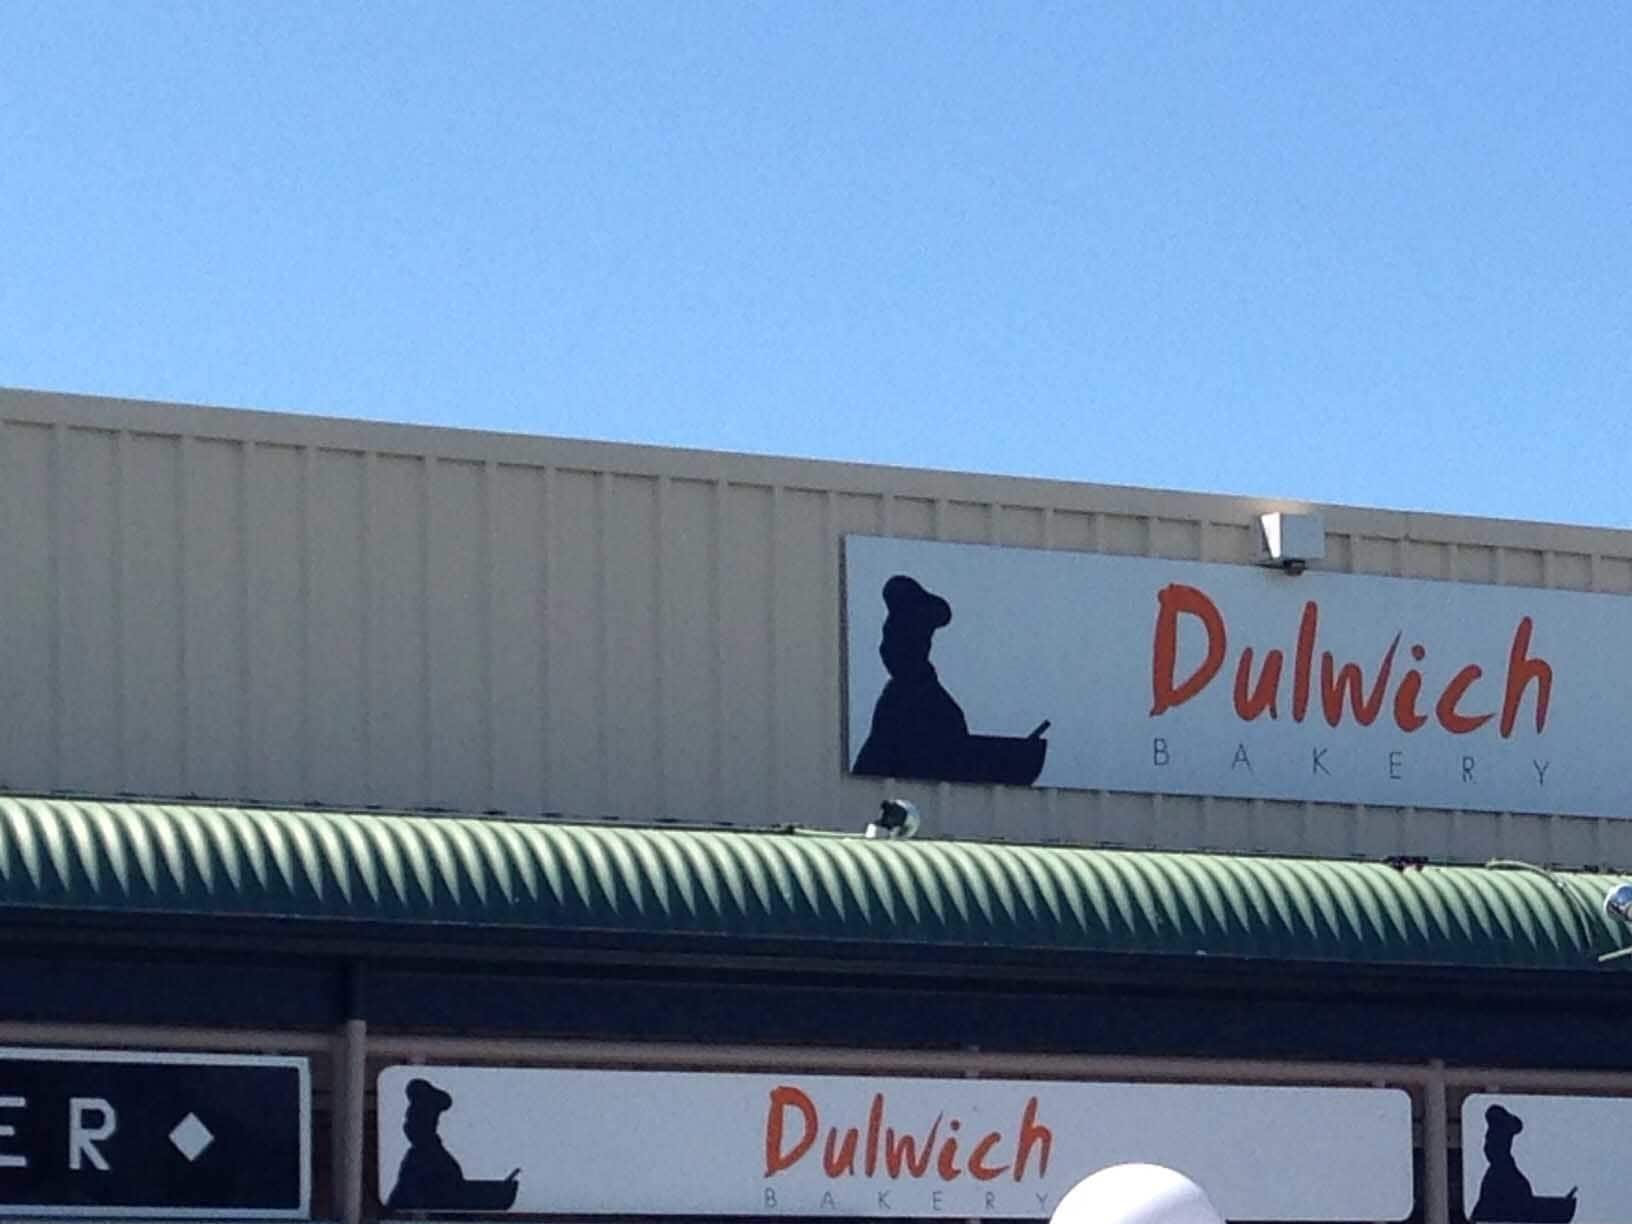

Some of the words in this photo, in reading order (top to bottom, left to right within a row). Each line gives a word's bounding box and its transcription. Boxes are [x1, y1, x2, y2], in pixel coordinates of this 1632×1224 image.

[1150, 583, 1553, 739] Dulwich
[1151, 737, 1551, 786] BAKERY
[763, 1085, 1052, 1183] Dulwich
[763, 1186, 1049, 1211] BAKERY
